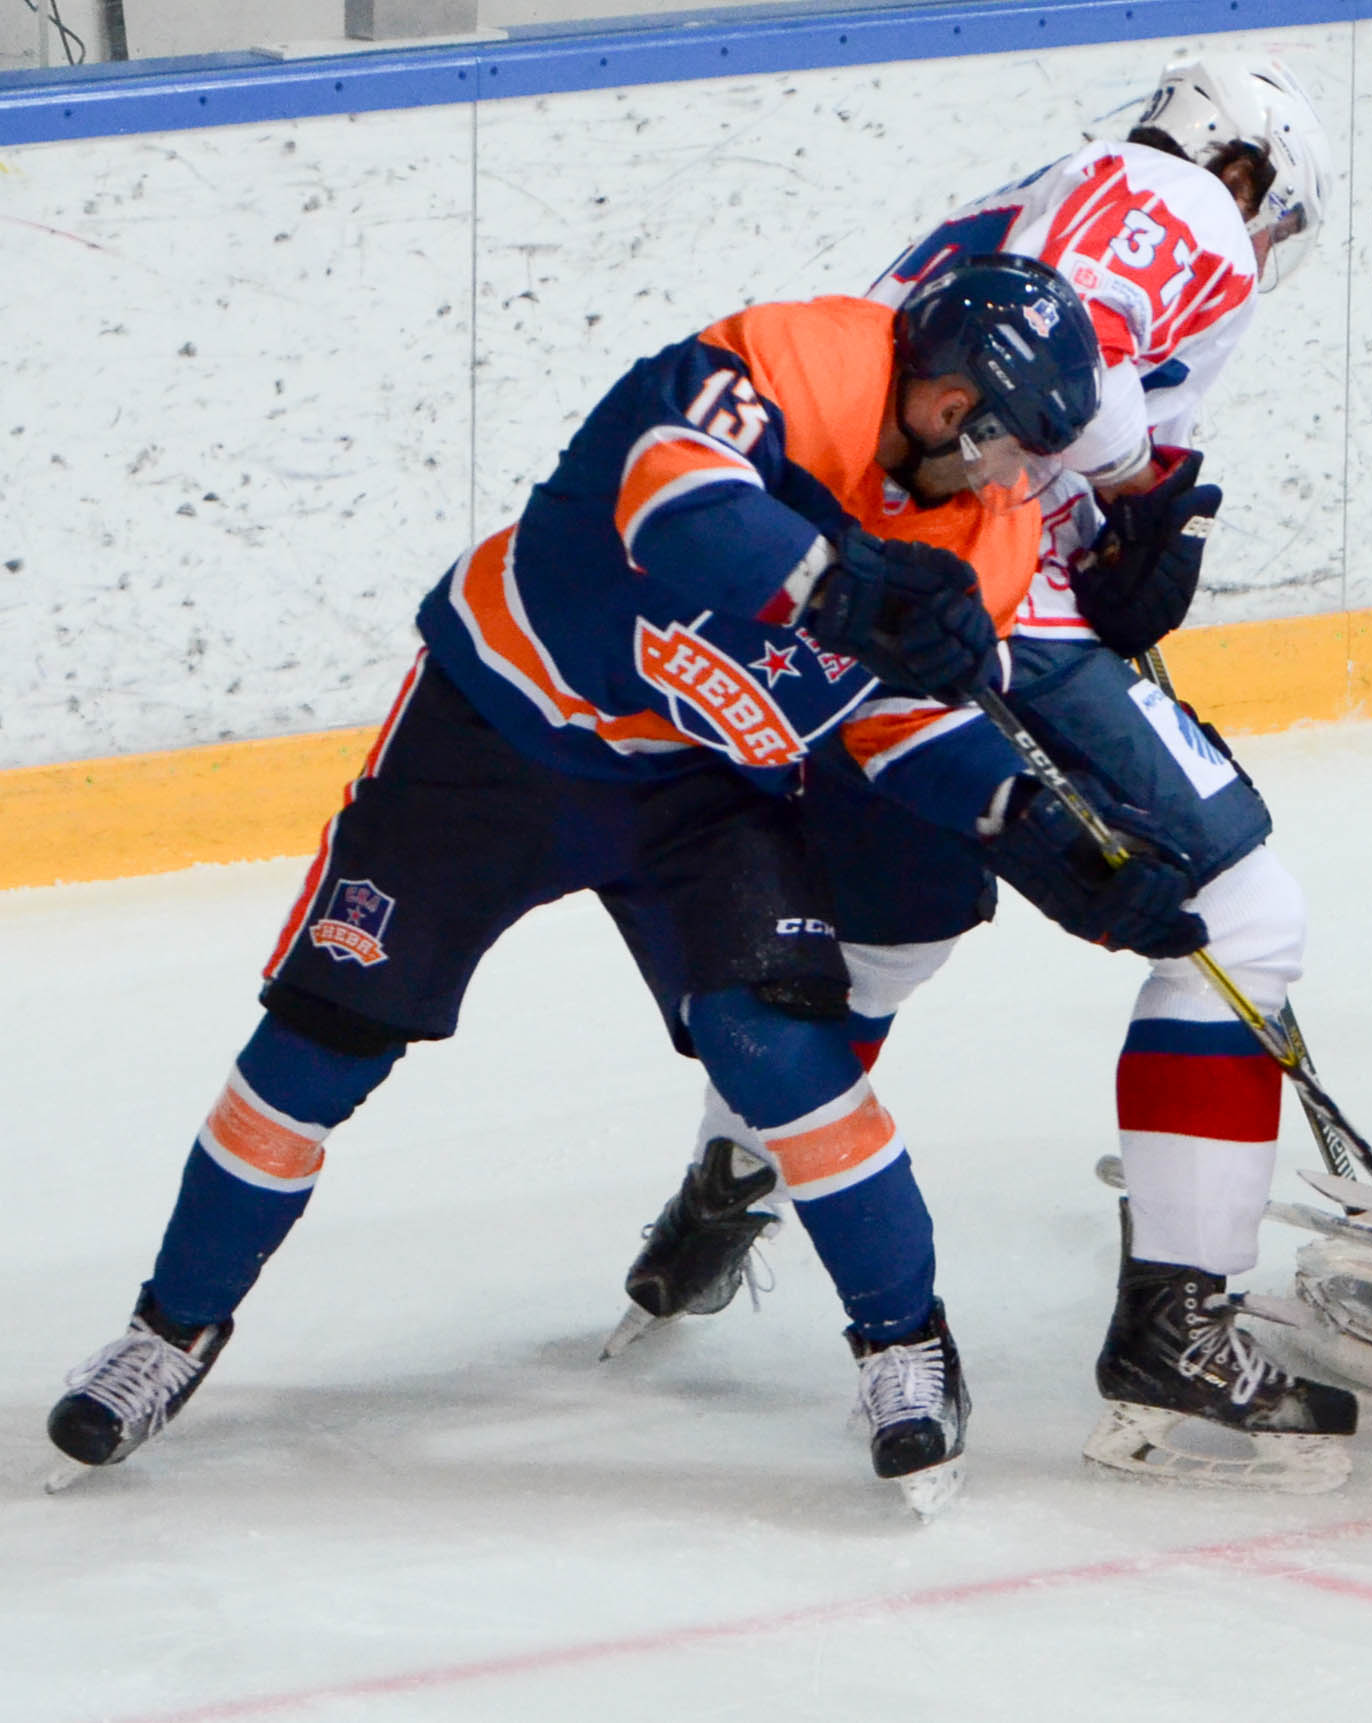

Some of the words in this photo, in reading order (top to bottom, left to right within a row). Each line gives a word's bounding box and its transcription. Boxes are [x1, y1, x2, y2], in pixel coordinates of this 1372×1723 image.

[1108, 207, 1196, 308] 37
[684, 367, 771, 456] 13
[662, 642, 788, 760] НЕВА
[1014, 728, 1067, 787] CCM
[320, 922, 374, 955] НЕВА
